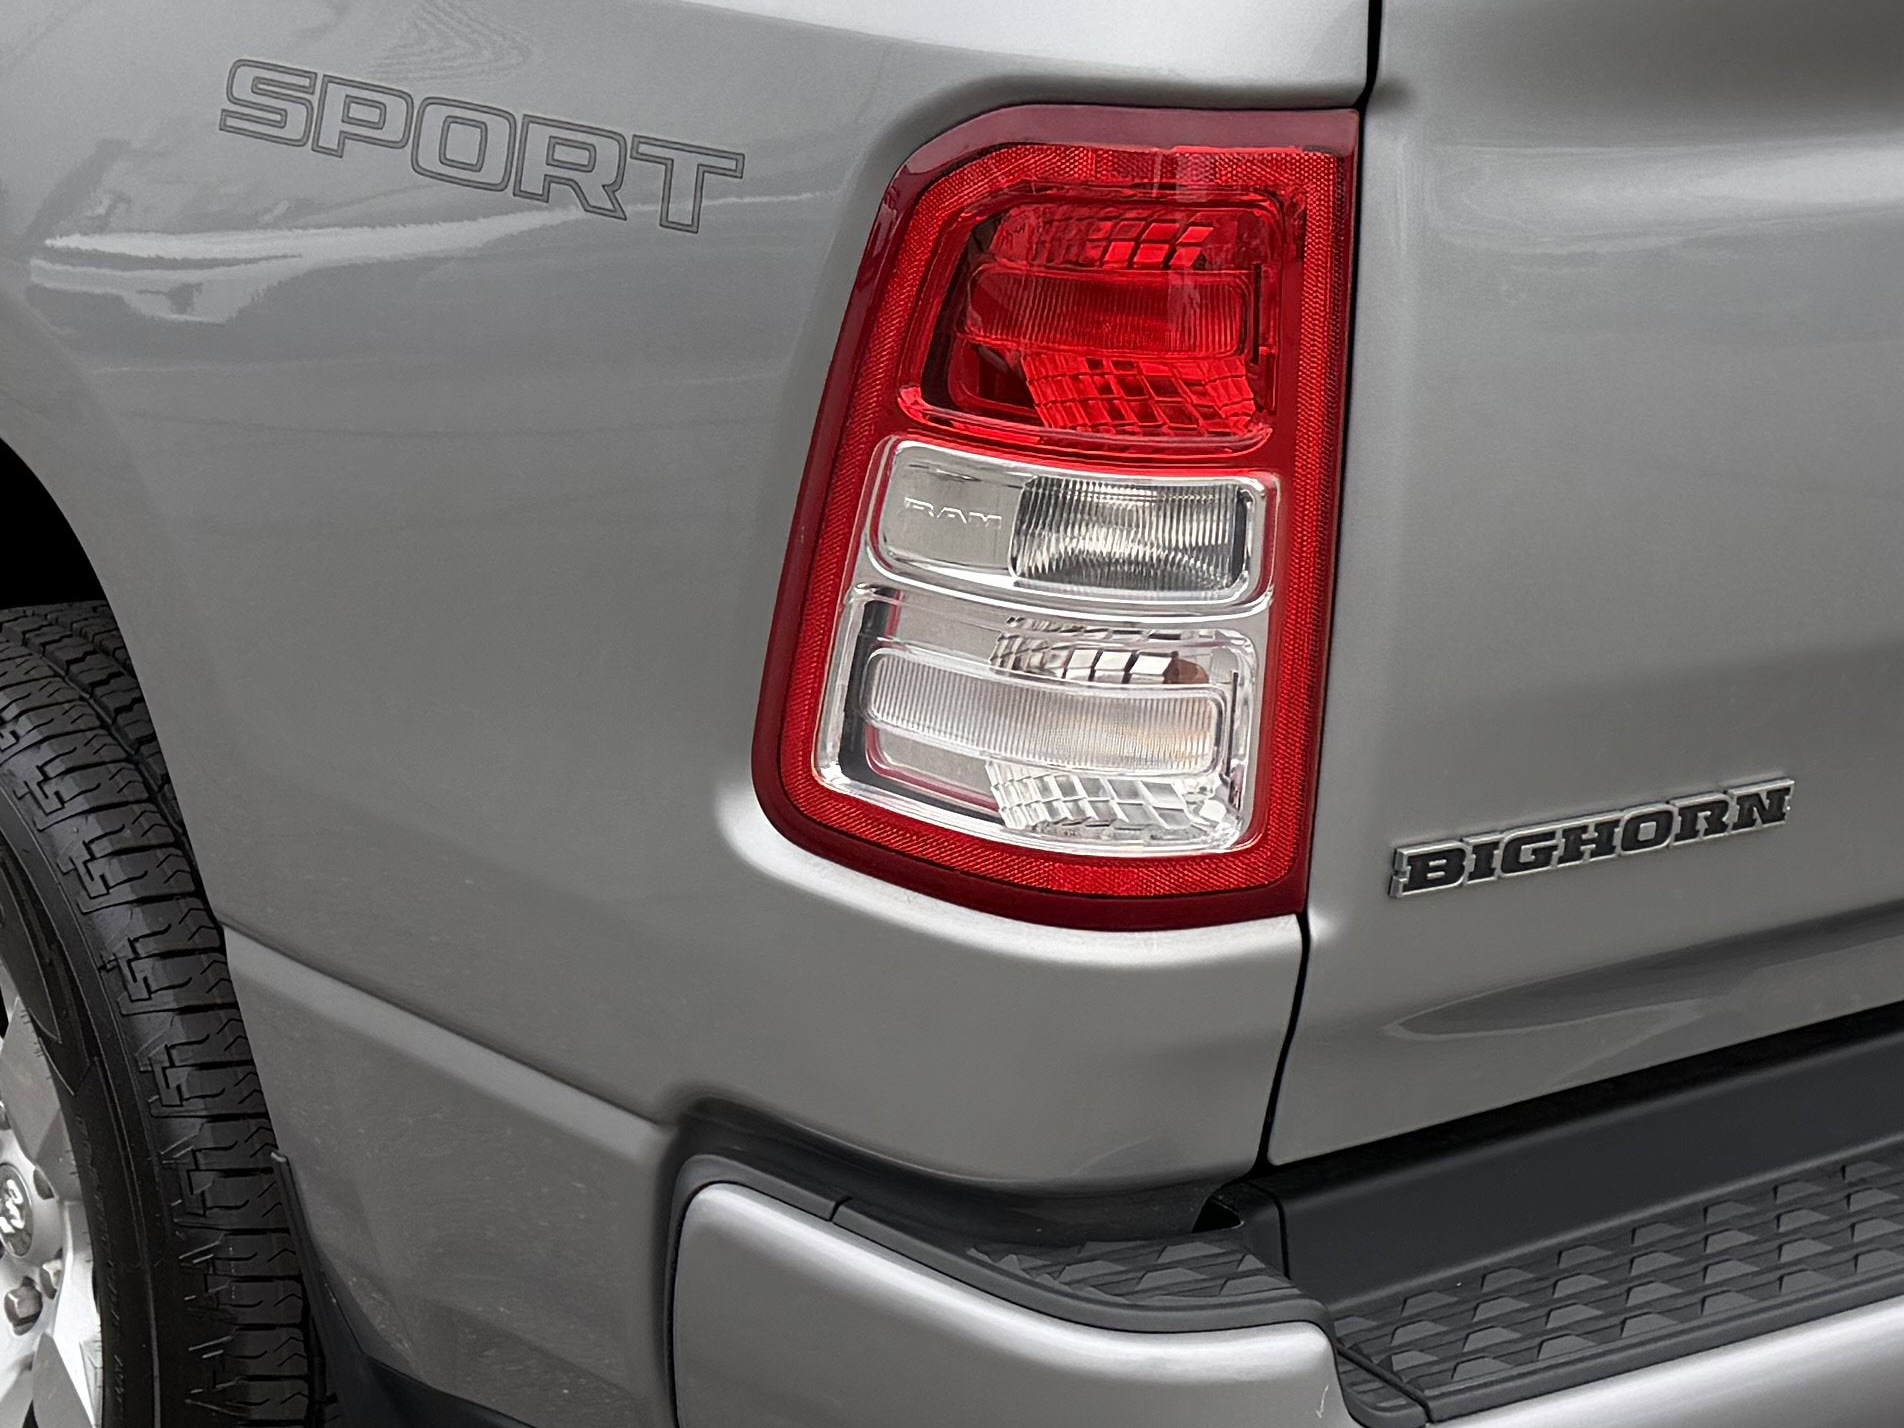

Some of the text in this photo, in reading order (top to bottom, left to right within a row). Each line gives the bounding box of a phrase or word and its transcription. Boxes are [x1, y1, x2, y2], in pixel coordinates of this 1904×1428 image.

[219, 58, 746, 234] SPORT
[903, 495, 1003, 531] RAM
[1387, 776, 1795, 899] BIGHORN
